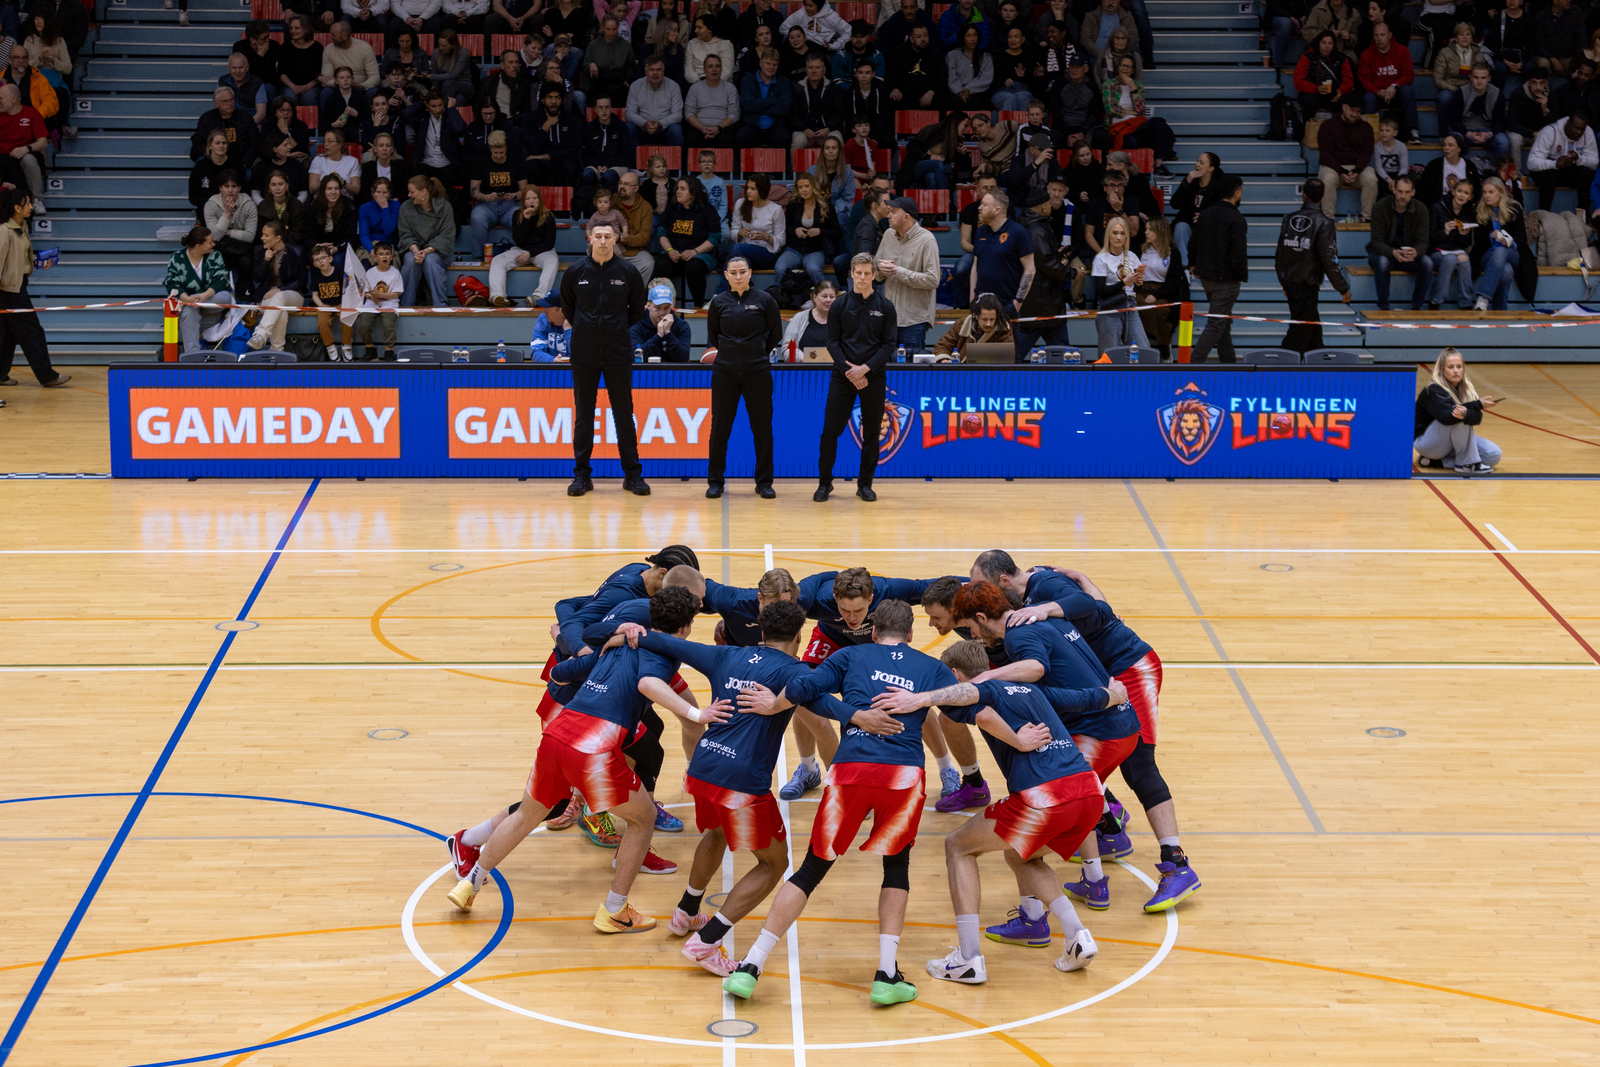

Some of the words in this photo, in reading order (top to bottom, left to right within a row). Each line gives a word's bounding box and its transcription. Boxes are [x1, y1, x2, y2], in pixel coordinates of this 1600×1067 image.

[79, 101, 89, 109] C
[1380, 154, 1399, 168] 73
[50, 180, 61, 188] C
[38, 220, 49, 228] C
[920, 396, 1047, 412] FYLLINGEN
[1230, 396, 1357, 412] FYLLINGEN
[137, 407, 395, 445] GAMEDAY
[919, 409, 1046, 450] LIONS
[1229, 409, 1356, 450] LIONS
[807, 640, 832, 660] 13
[890, 652, 905, 663] 25
[871, 670, 916, 692] Joma
